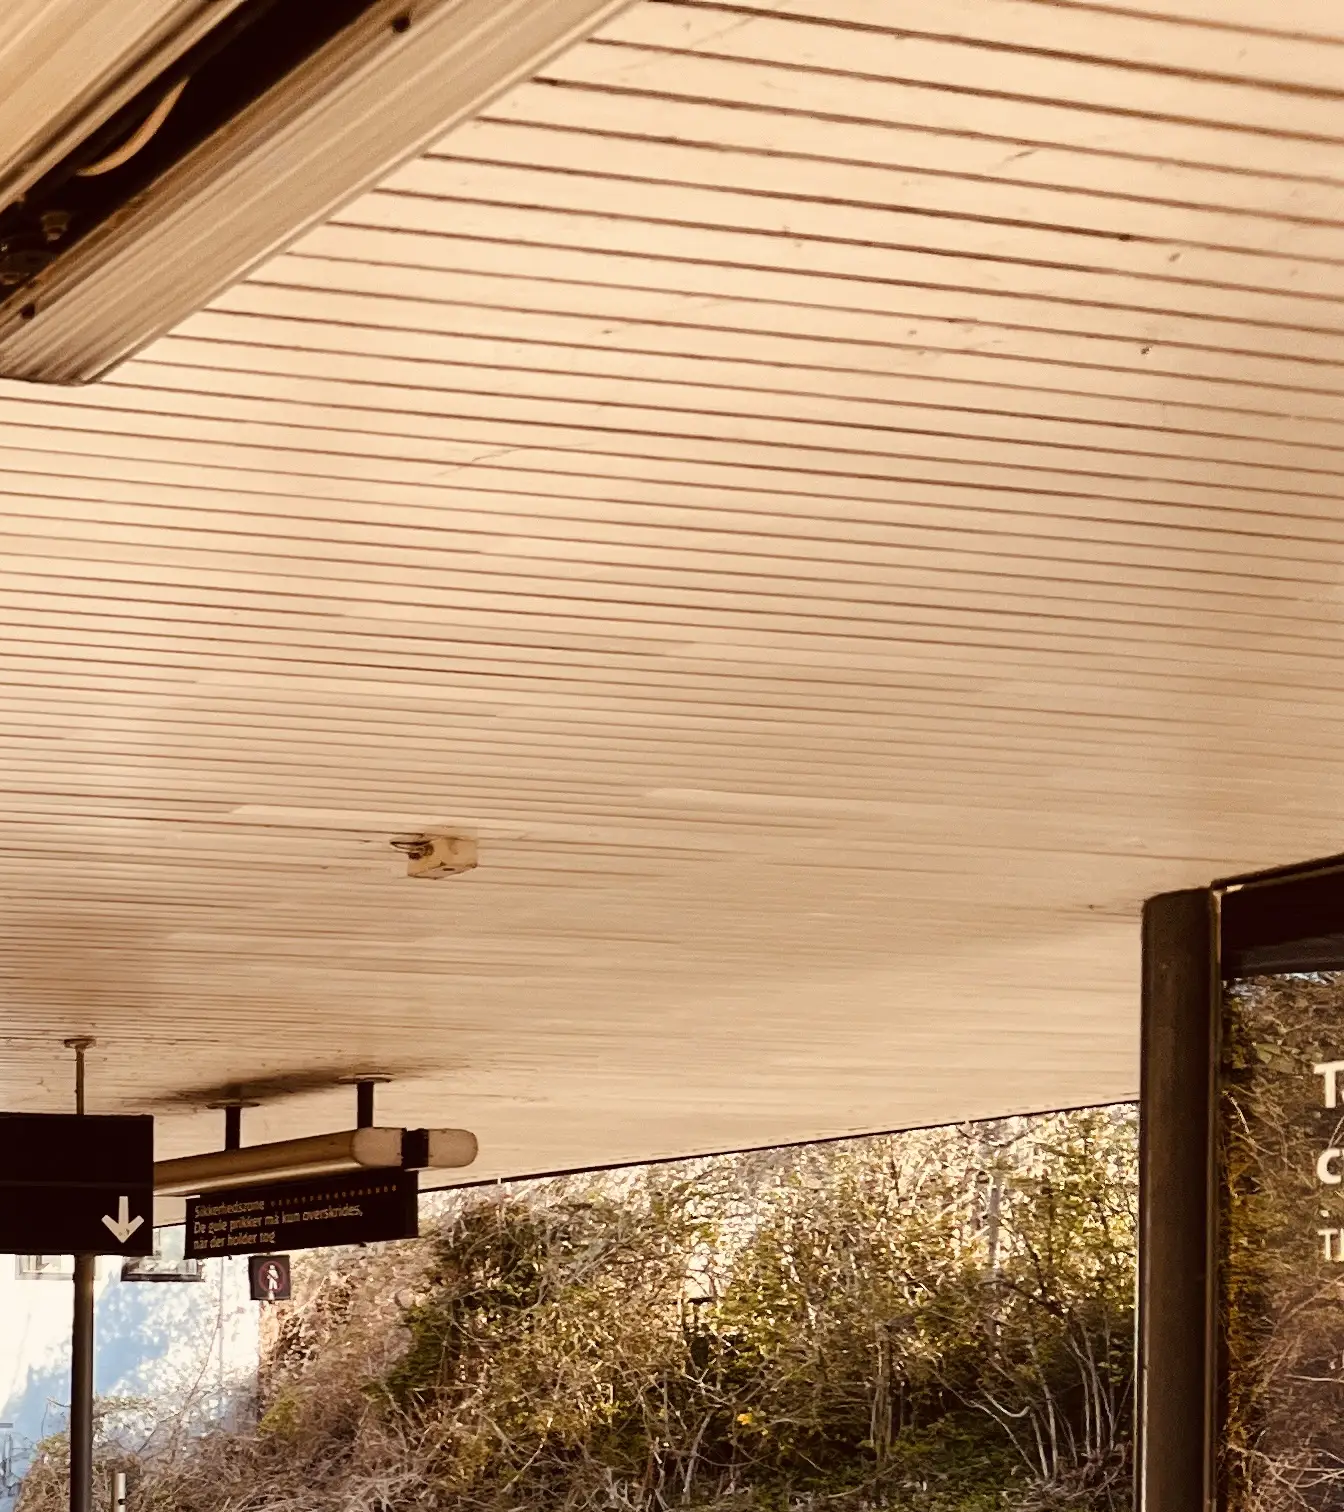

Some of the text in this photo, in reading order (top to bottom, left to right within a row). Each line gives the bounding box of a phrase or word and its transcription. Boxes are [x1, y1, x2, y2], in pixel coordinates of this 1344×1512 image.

[194, 1221, 206, 1235] De
[208, 1219, 228, 1235] gule
[230, 1216, 262, 1233] prikker
[282, 1210, 300, 1224] kun
[193, 1231, 276, 1250] når der holder tog
